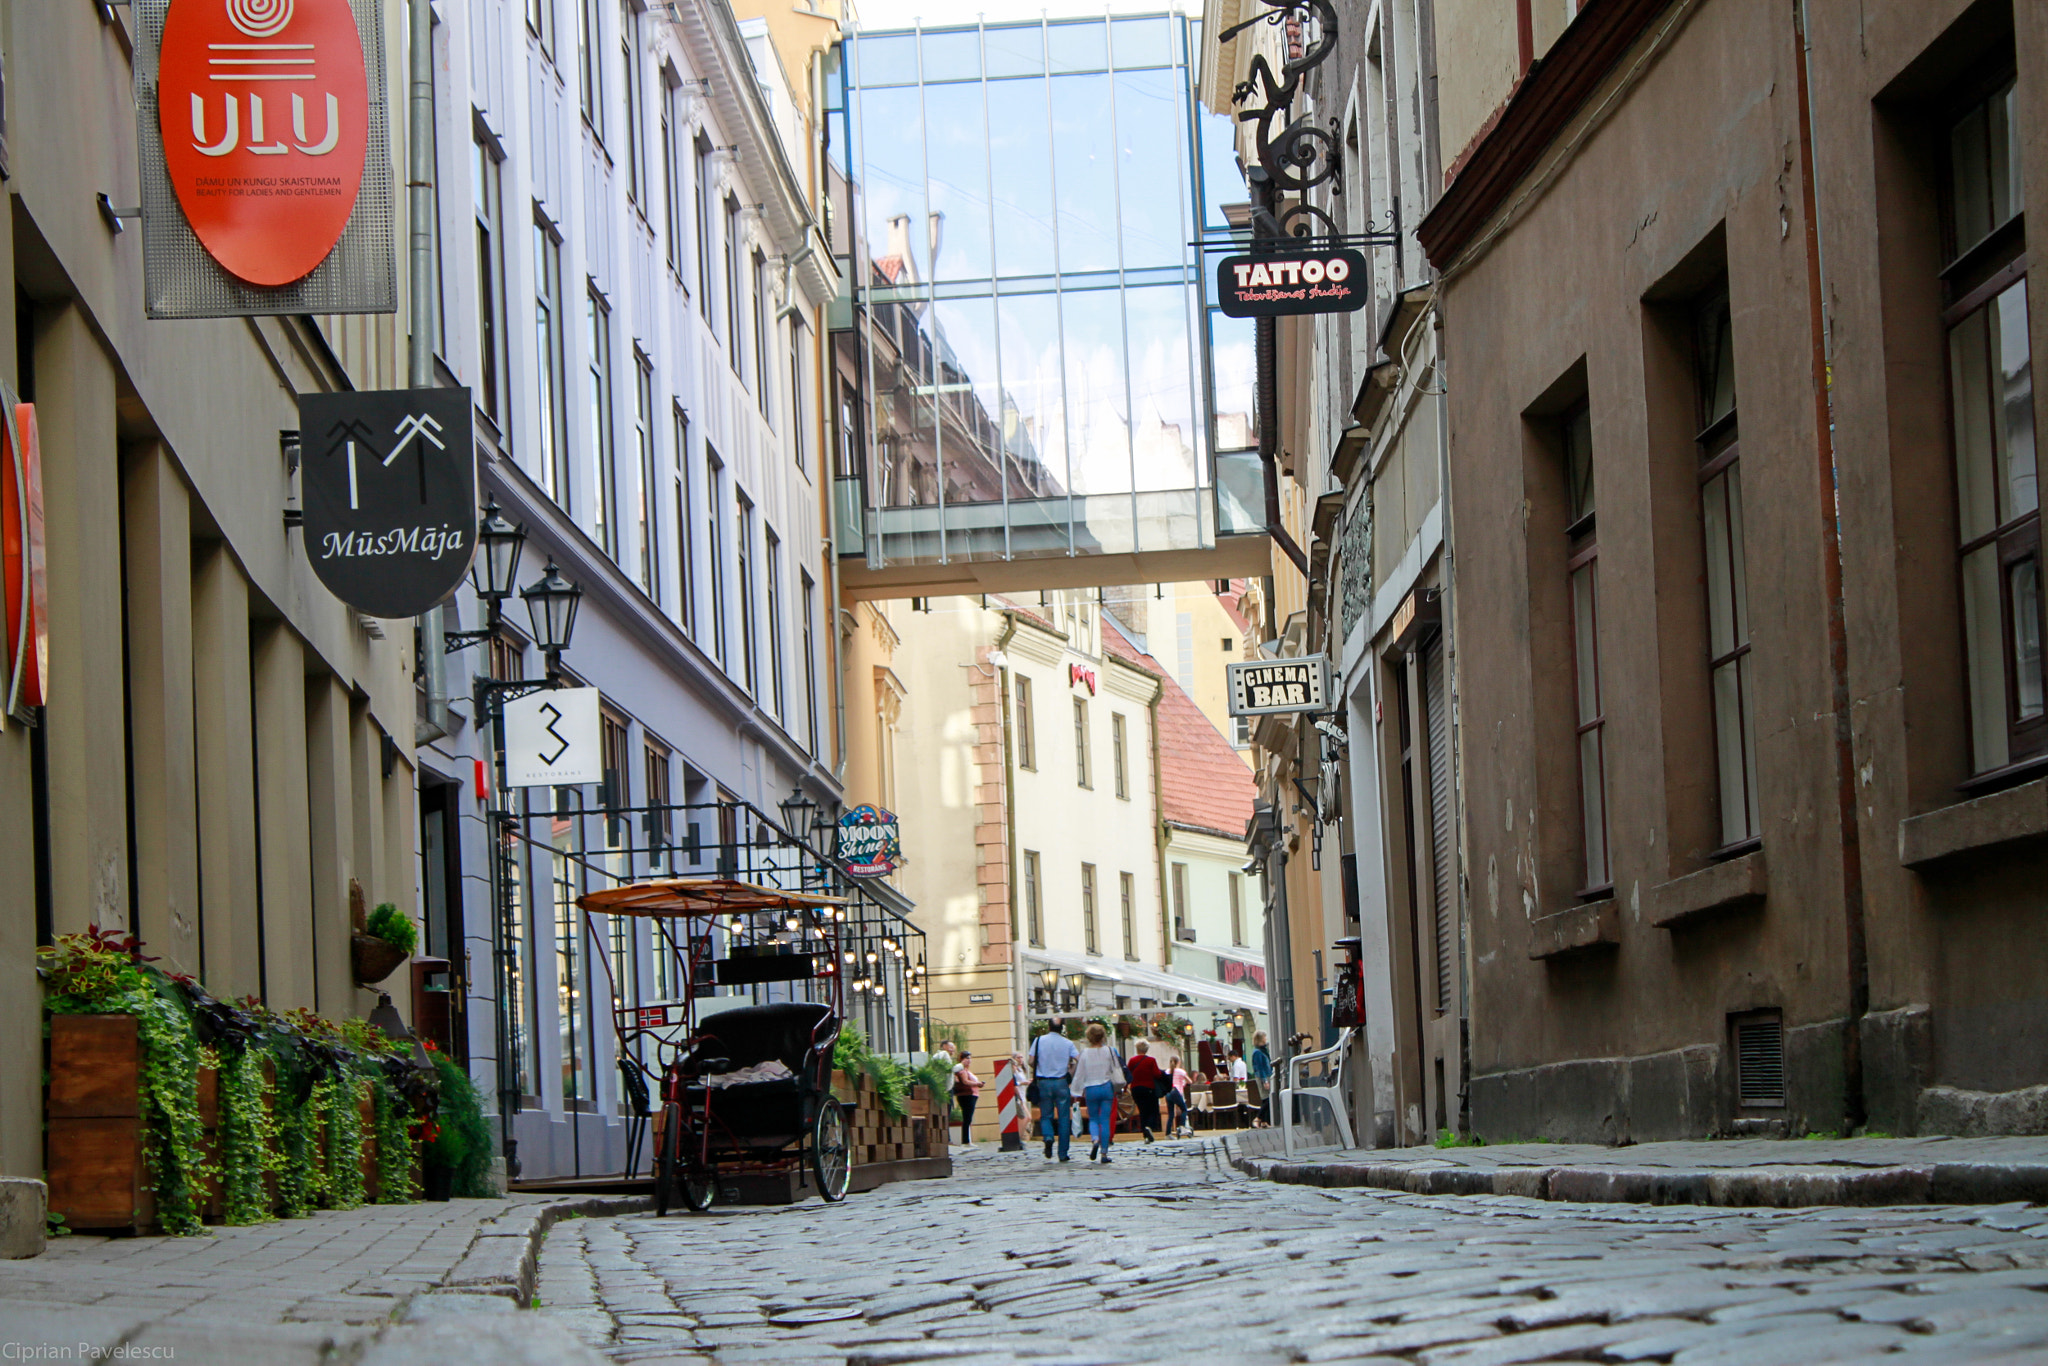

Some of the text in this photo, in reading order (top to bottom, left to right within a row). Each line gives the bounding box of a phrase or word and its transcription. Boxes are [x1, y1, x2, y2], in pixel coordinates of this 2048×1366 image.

[190, 91, 339, 157] ULU
[196, 187, 342, 197] BEAUTY FOR LADIES AND GENTLEMEN
[227, 177, 242, 186] UN
[243, 177, 277, 186] KUNGU
[279, 176, 341, 186] SKAISTUMAM
[1233, 258, 1350, 288] TATTOO
[321, 522, 464, 561] MūsMāja
[1245, 666, 1308, 687] CINEMA
[1253, 683, 1306, 707] BAR
[537, 701, 570, 767] 3
[838, 824, 897, 843] MOON
[837, 840, 884, 859] Shine
